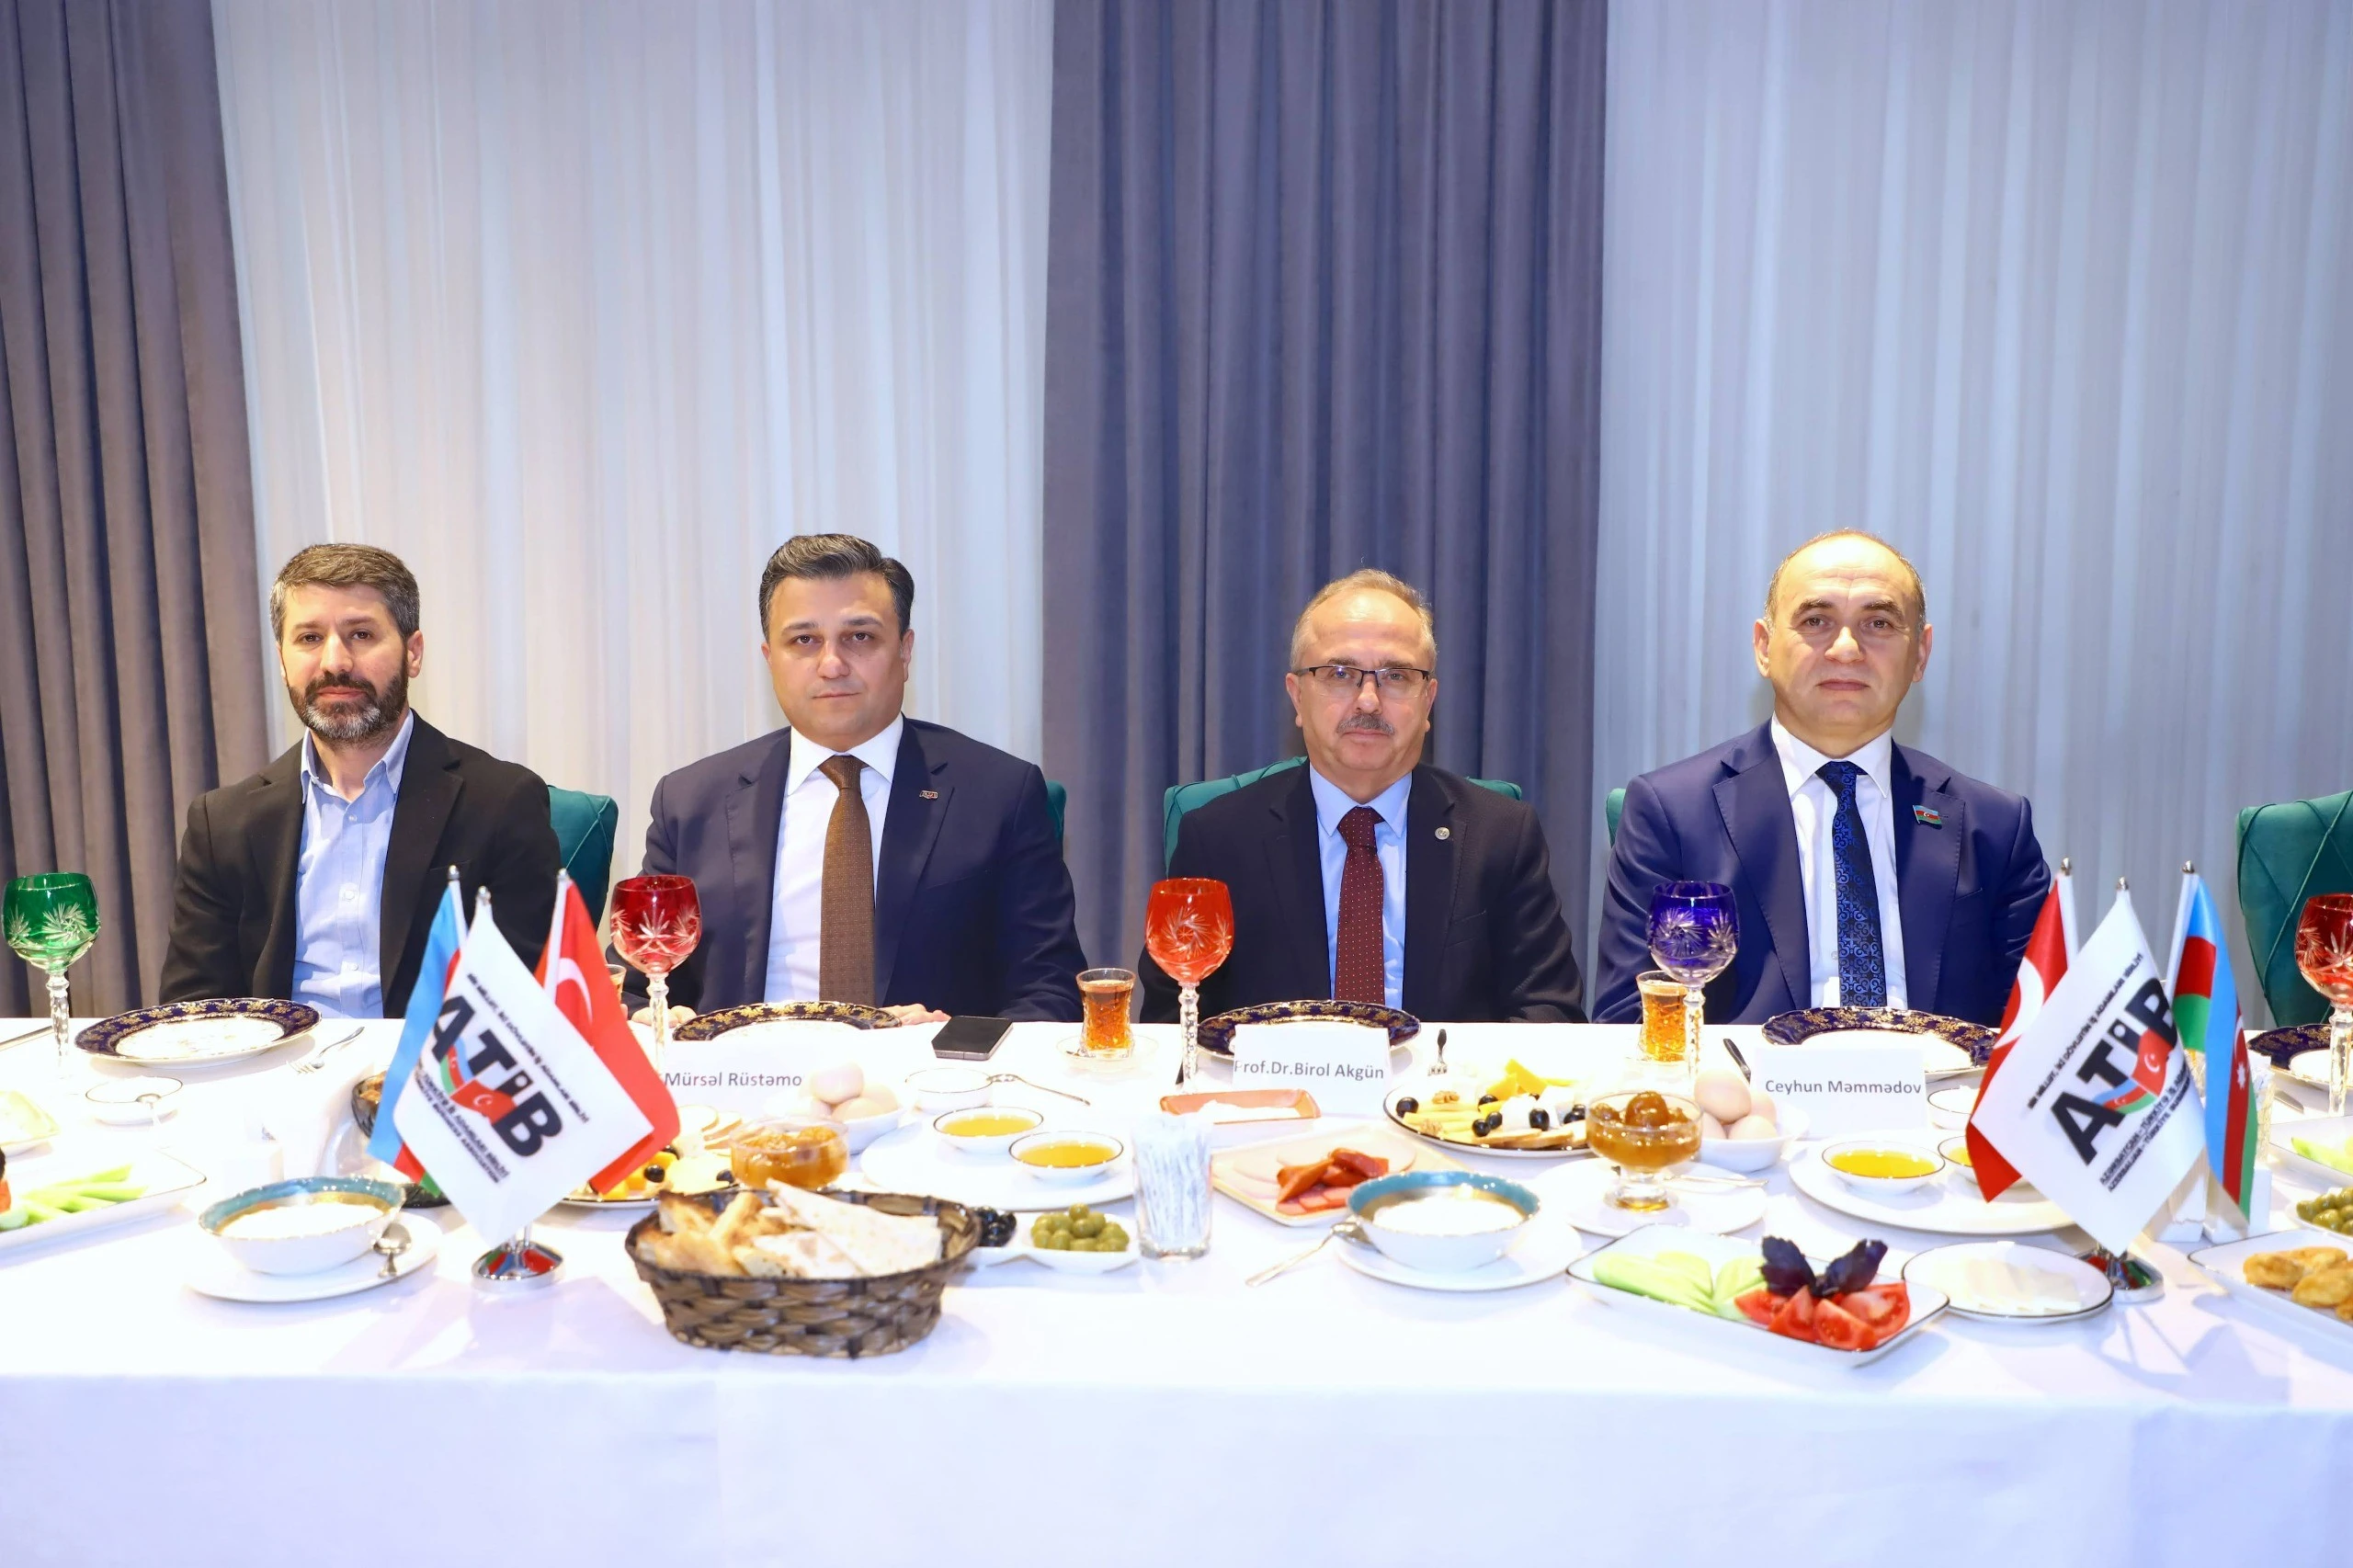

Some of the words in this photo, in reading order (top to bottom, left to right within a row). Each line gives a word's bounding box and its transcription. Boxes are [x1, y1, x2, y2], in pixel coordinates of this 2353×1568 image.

[1234, 1060, 1330, 1077] Prof.Dr.Birol
[1335, 1064, 1384, 1081] Akgün
[665, 1072, 722, 1086] Mürsəl
[729, 1073, 802, 1086] Rüstəmo
[1765, 1080, 1823, 1095] Ceyhun
[1828, 1080, 1922, 1094] Məmmədov
